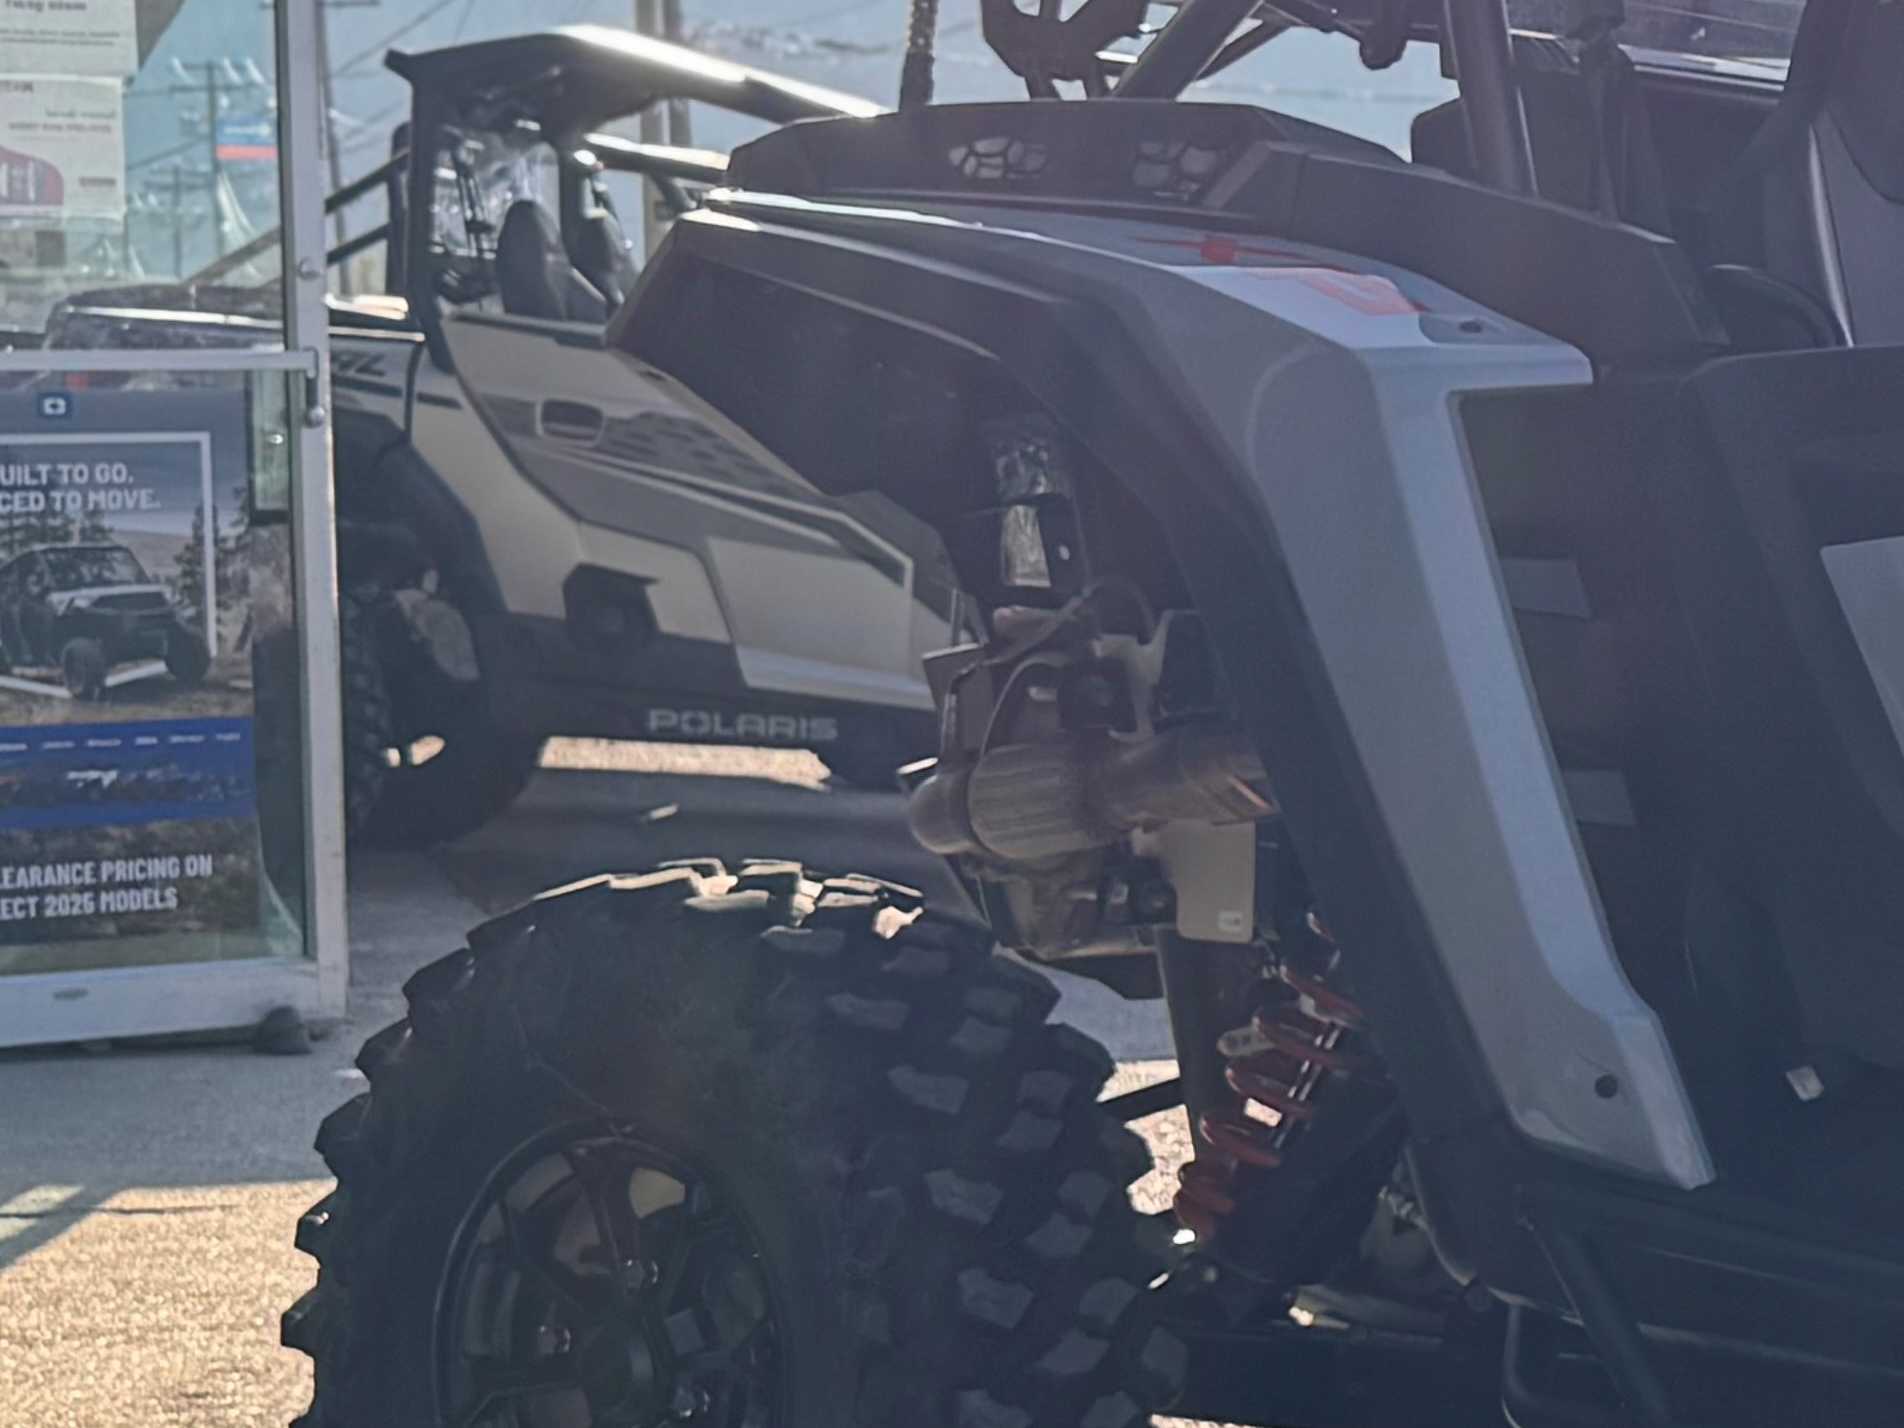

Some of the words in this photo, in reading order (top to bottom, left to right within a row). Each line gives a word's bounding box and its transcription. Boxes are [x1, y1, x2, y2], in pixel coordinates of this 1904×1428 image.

[57, 463, 90, 484] TO
[94, 462, 134, 484] GO.
[50, 490, 82, 512] TO
[87, 488, 161, 511] MOVE.
[648, 708, 839, 741] POLARIS
[0, 862, 97, 890] EARANCE
[101, 856, 181, 884] PRICING
[184, 854, 213, 877] ON
[101, 887, 178, 914] MODELS
